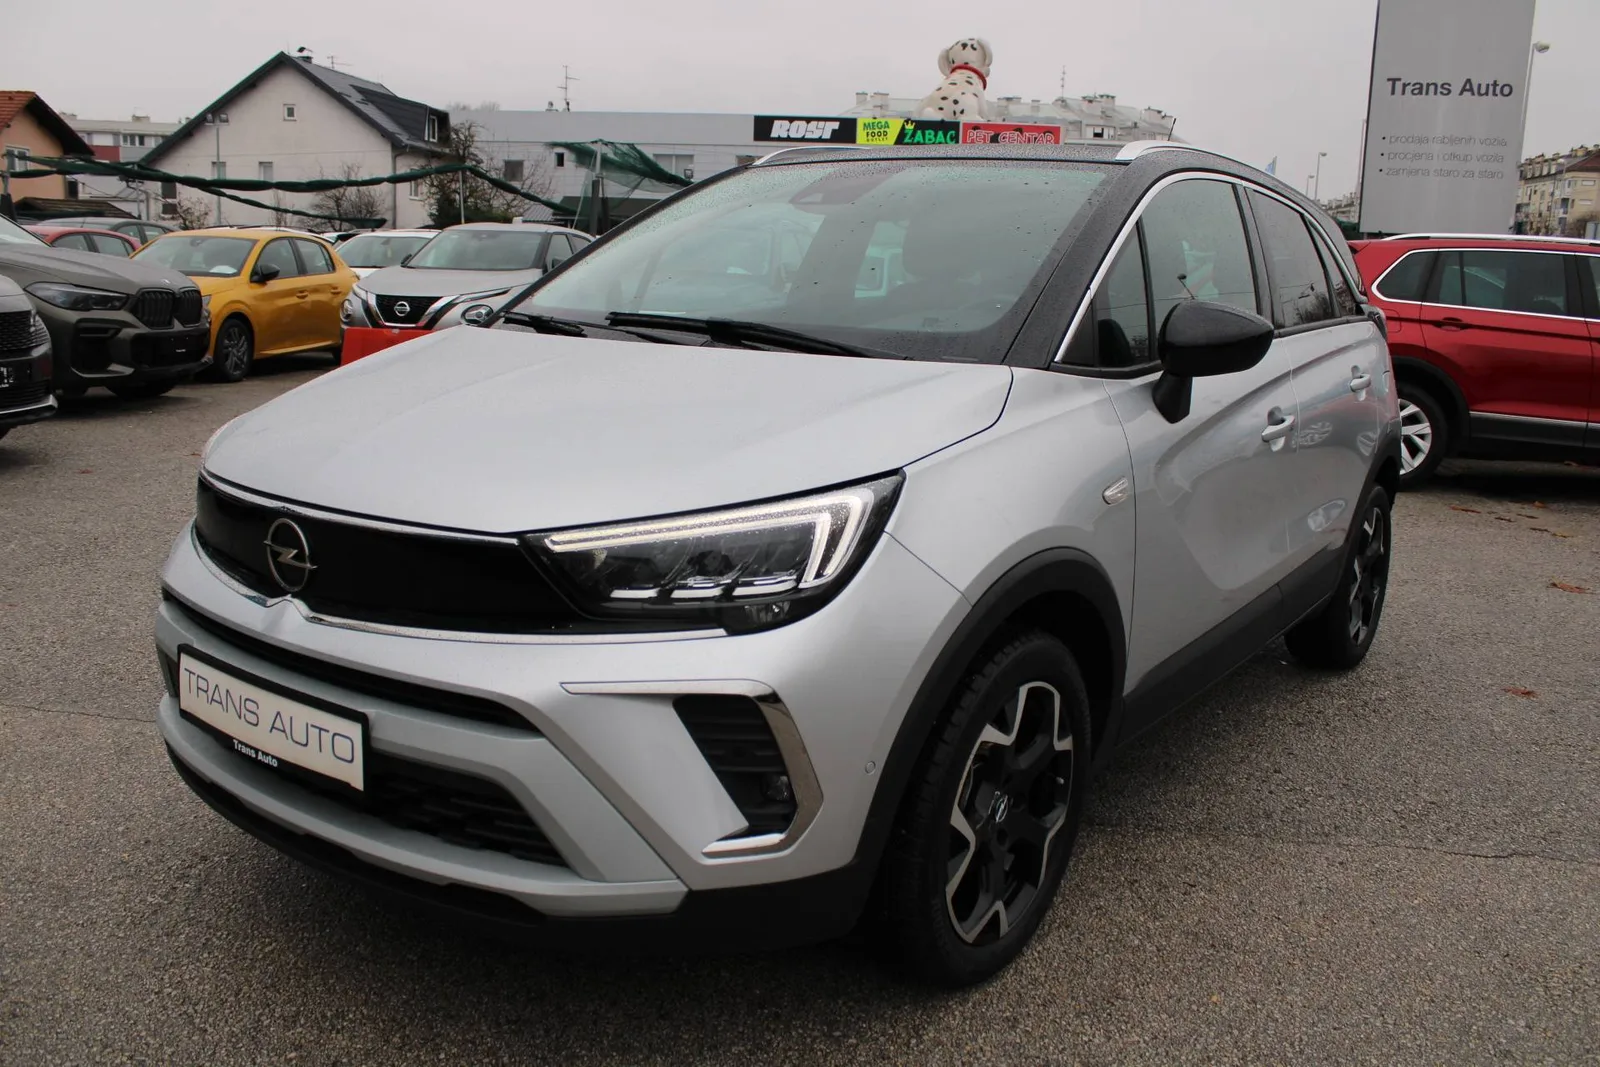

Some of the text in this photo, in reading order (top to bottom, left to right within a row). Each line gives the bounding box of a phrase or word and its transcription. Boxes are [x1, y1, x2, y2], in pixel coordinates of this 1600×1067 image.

[1386, 78, 1513, 98] Trans Auto
[770, 119, 840, 139] ROST
[863, 120, 890, 131] MEGA
[866, 130, 889, 138] FOOD
[967, 129, 1055, 144] PET CENTAR
[1388, 134, 1430, 146] prodaja
[1433, 168, 1460, 178] staro
[1462, 169, 1475, 178] za
[1478, 169, 1504, 180] staro
[184, 667, 355, 764] TRANS AUTO
[232, 739, 278, 767] Trans Auto
